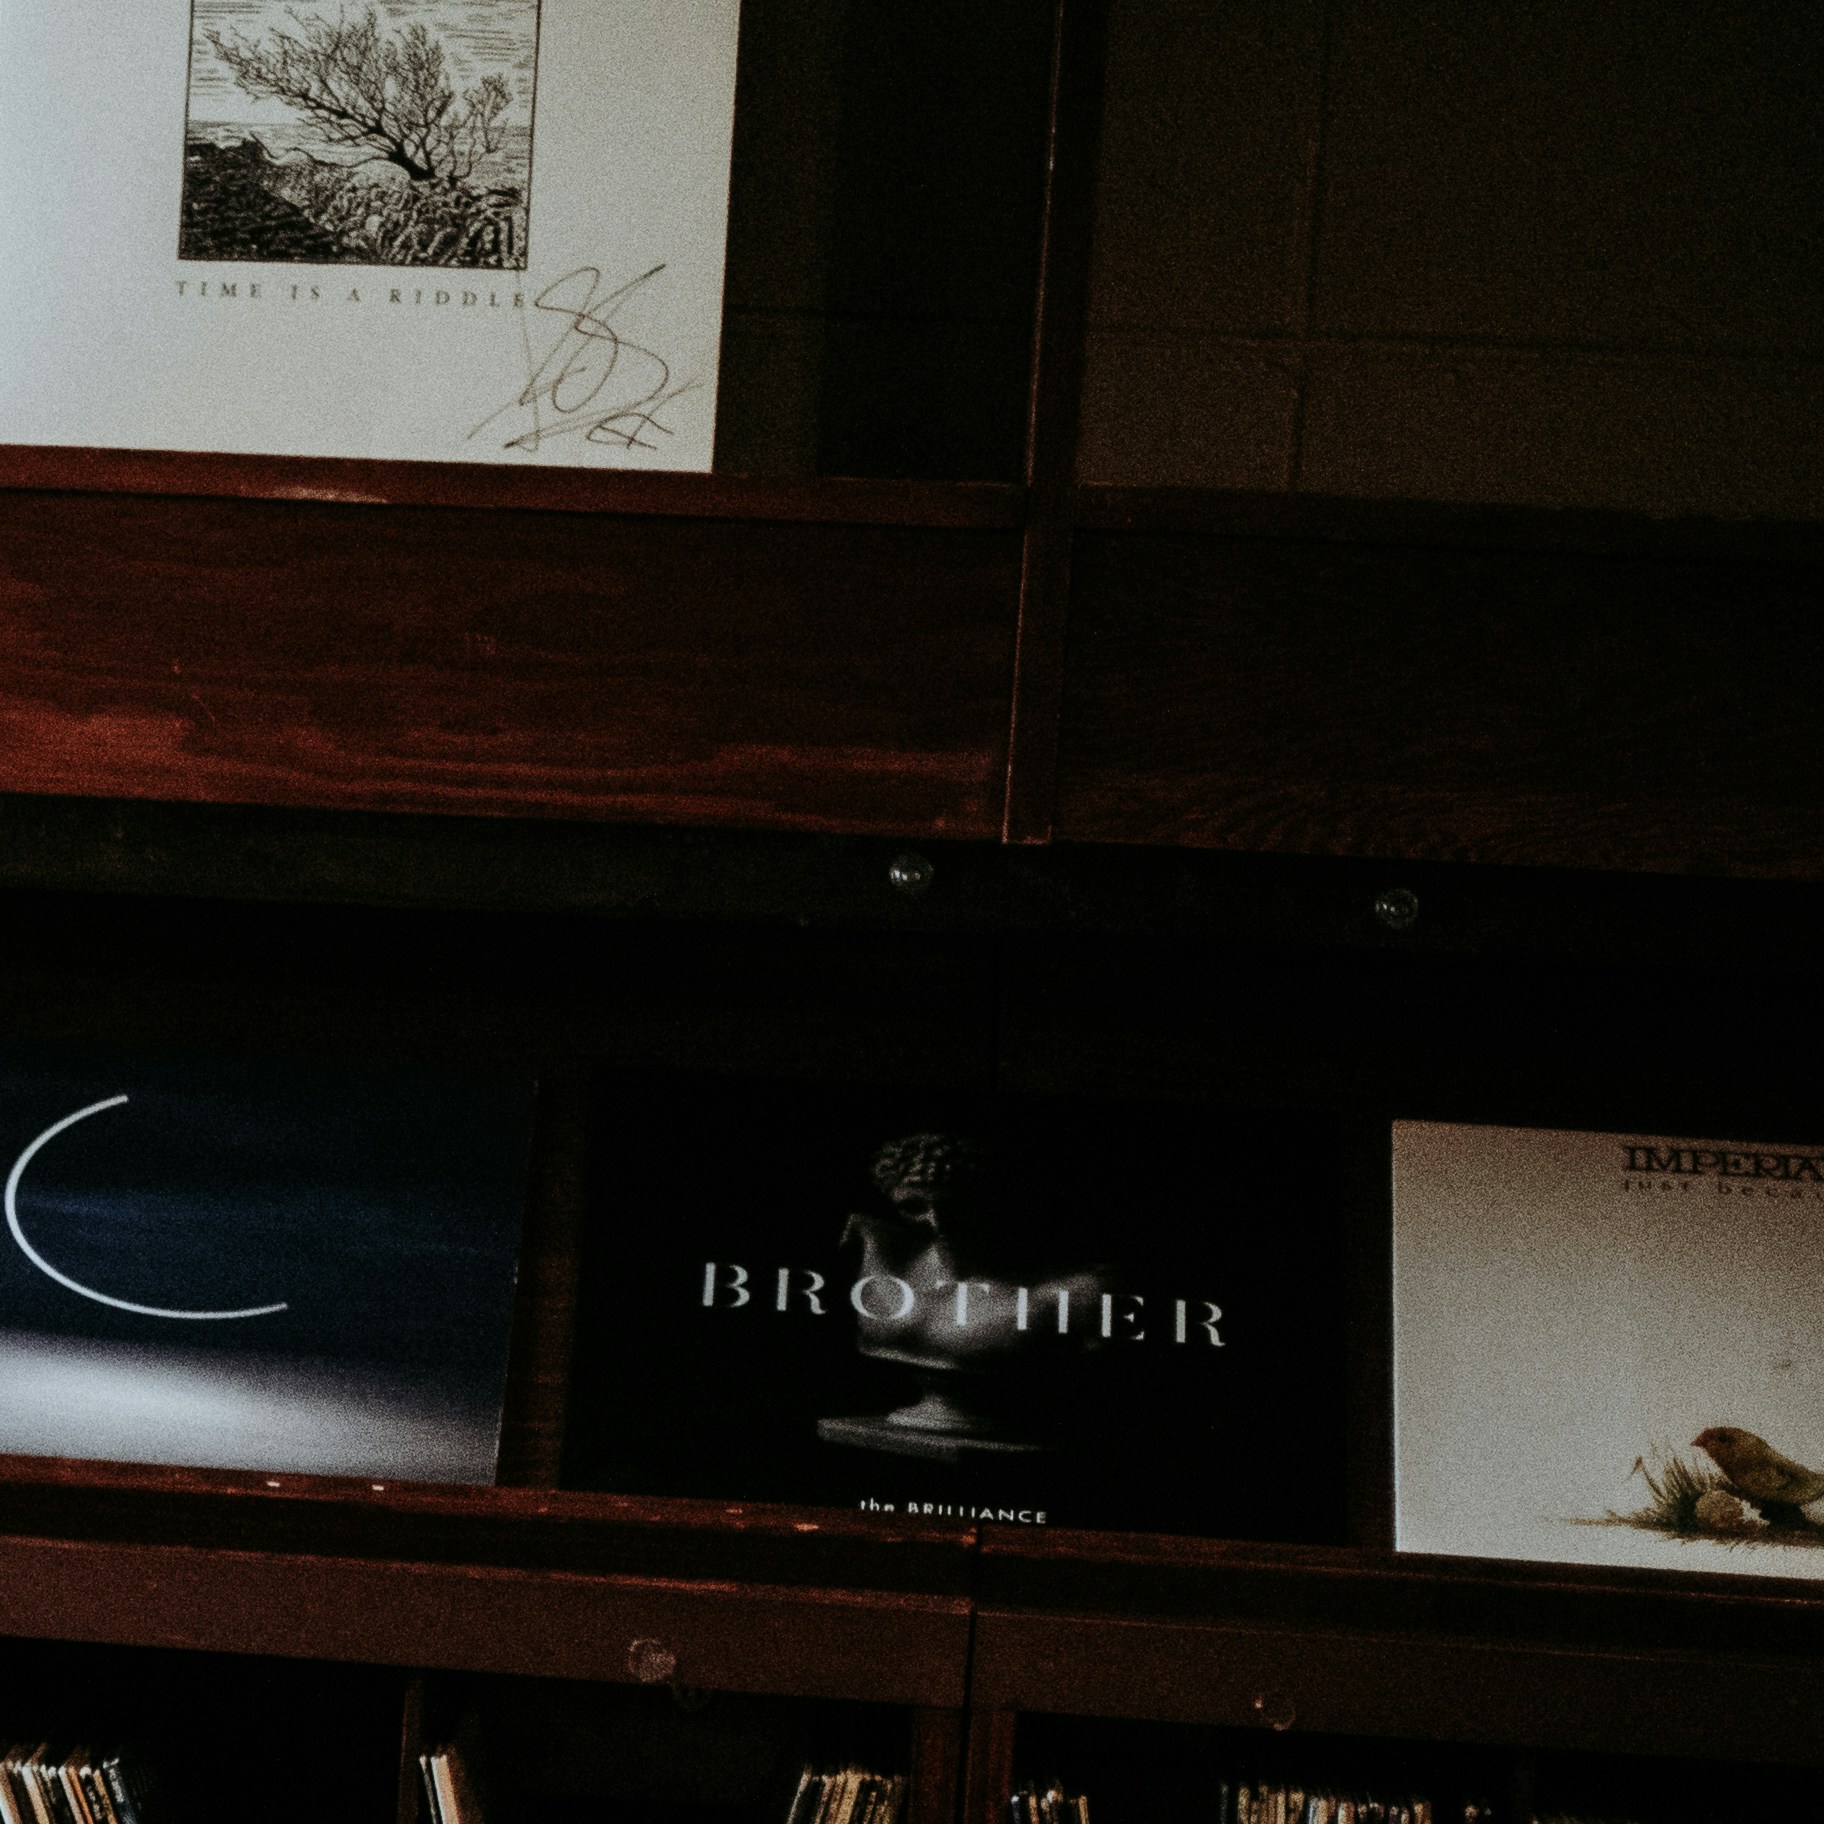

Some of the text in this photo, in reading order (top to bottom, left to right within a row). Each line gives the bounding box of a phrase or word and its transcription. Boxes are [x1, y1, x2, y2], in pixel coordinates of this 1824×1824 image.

[175, 280, 525, 308] TIME IS A RIDDLE
[701, 1260, 1227, 1348] BROTHER
[860, 1497, 1048, 1524] the BRILLIANCE
